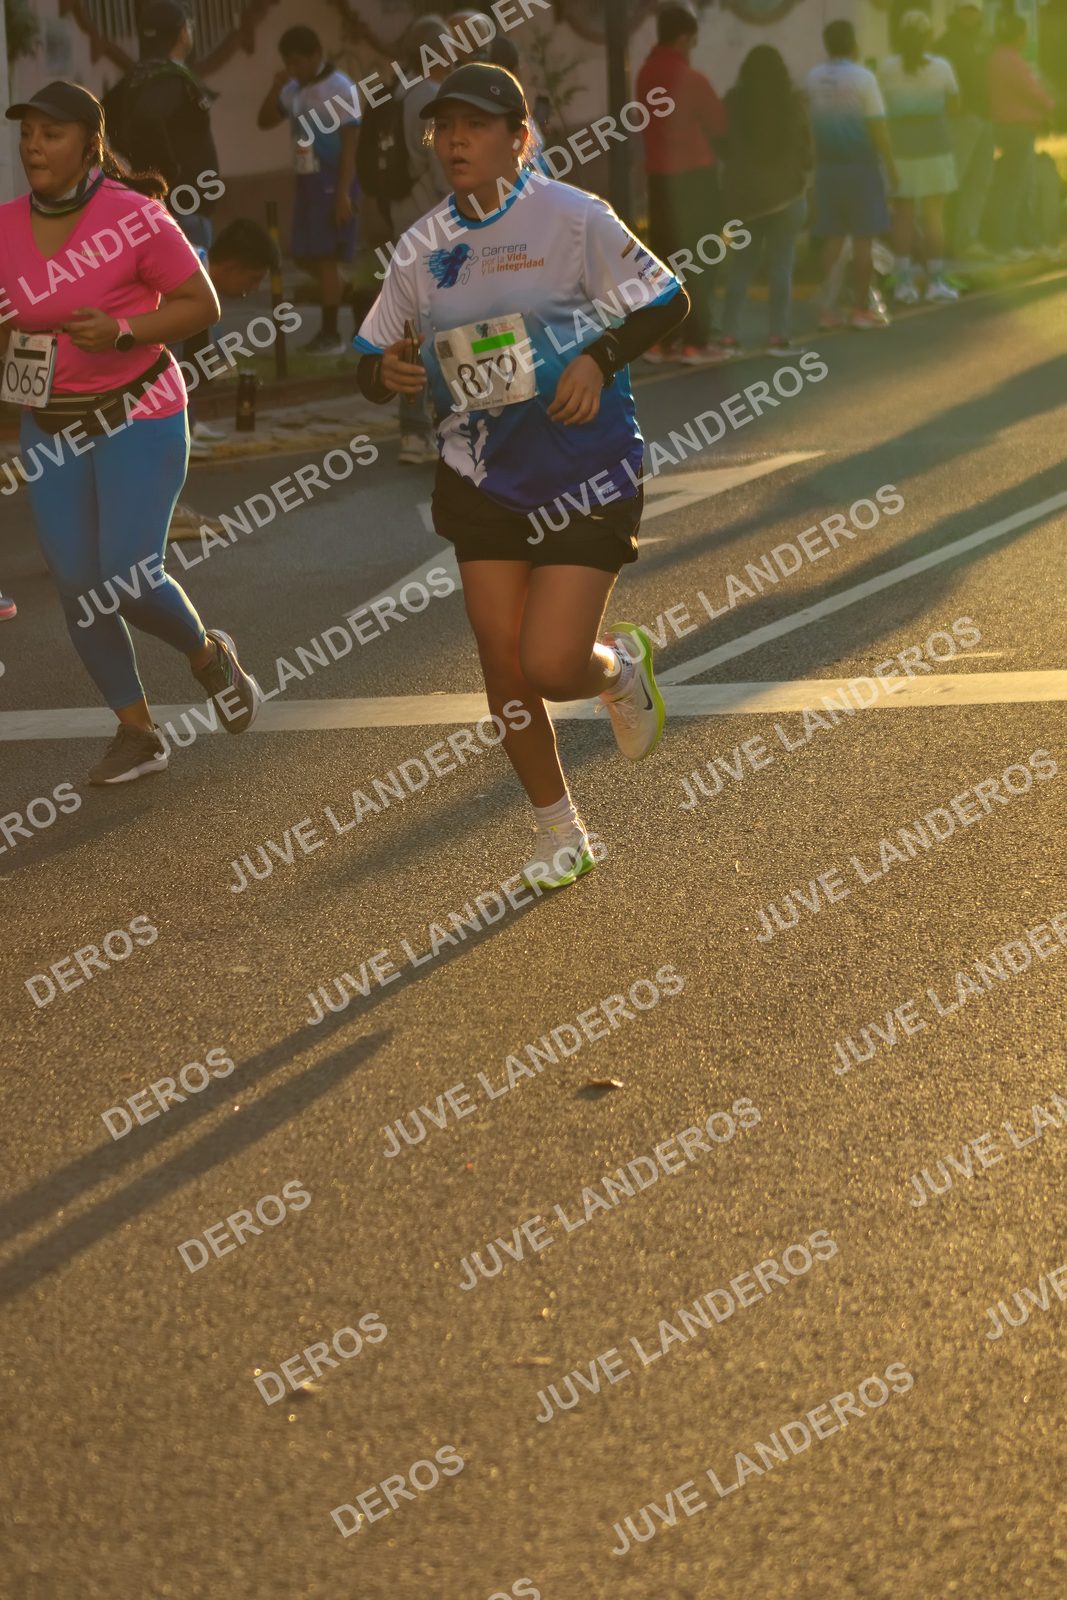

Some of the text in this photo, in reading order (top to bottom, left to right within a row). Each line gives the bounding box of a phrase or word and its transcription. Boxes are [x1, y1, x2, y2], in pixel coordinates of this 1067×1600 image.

[481, 243, 527, 257] Carrera
[507, 252, 527, 262] Vida
[6, 361, 48, 397] 065
[457, 353, 517, 398] 879
